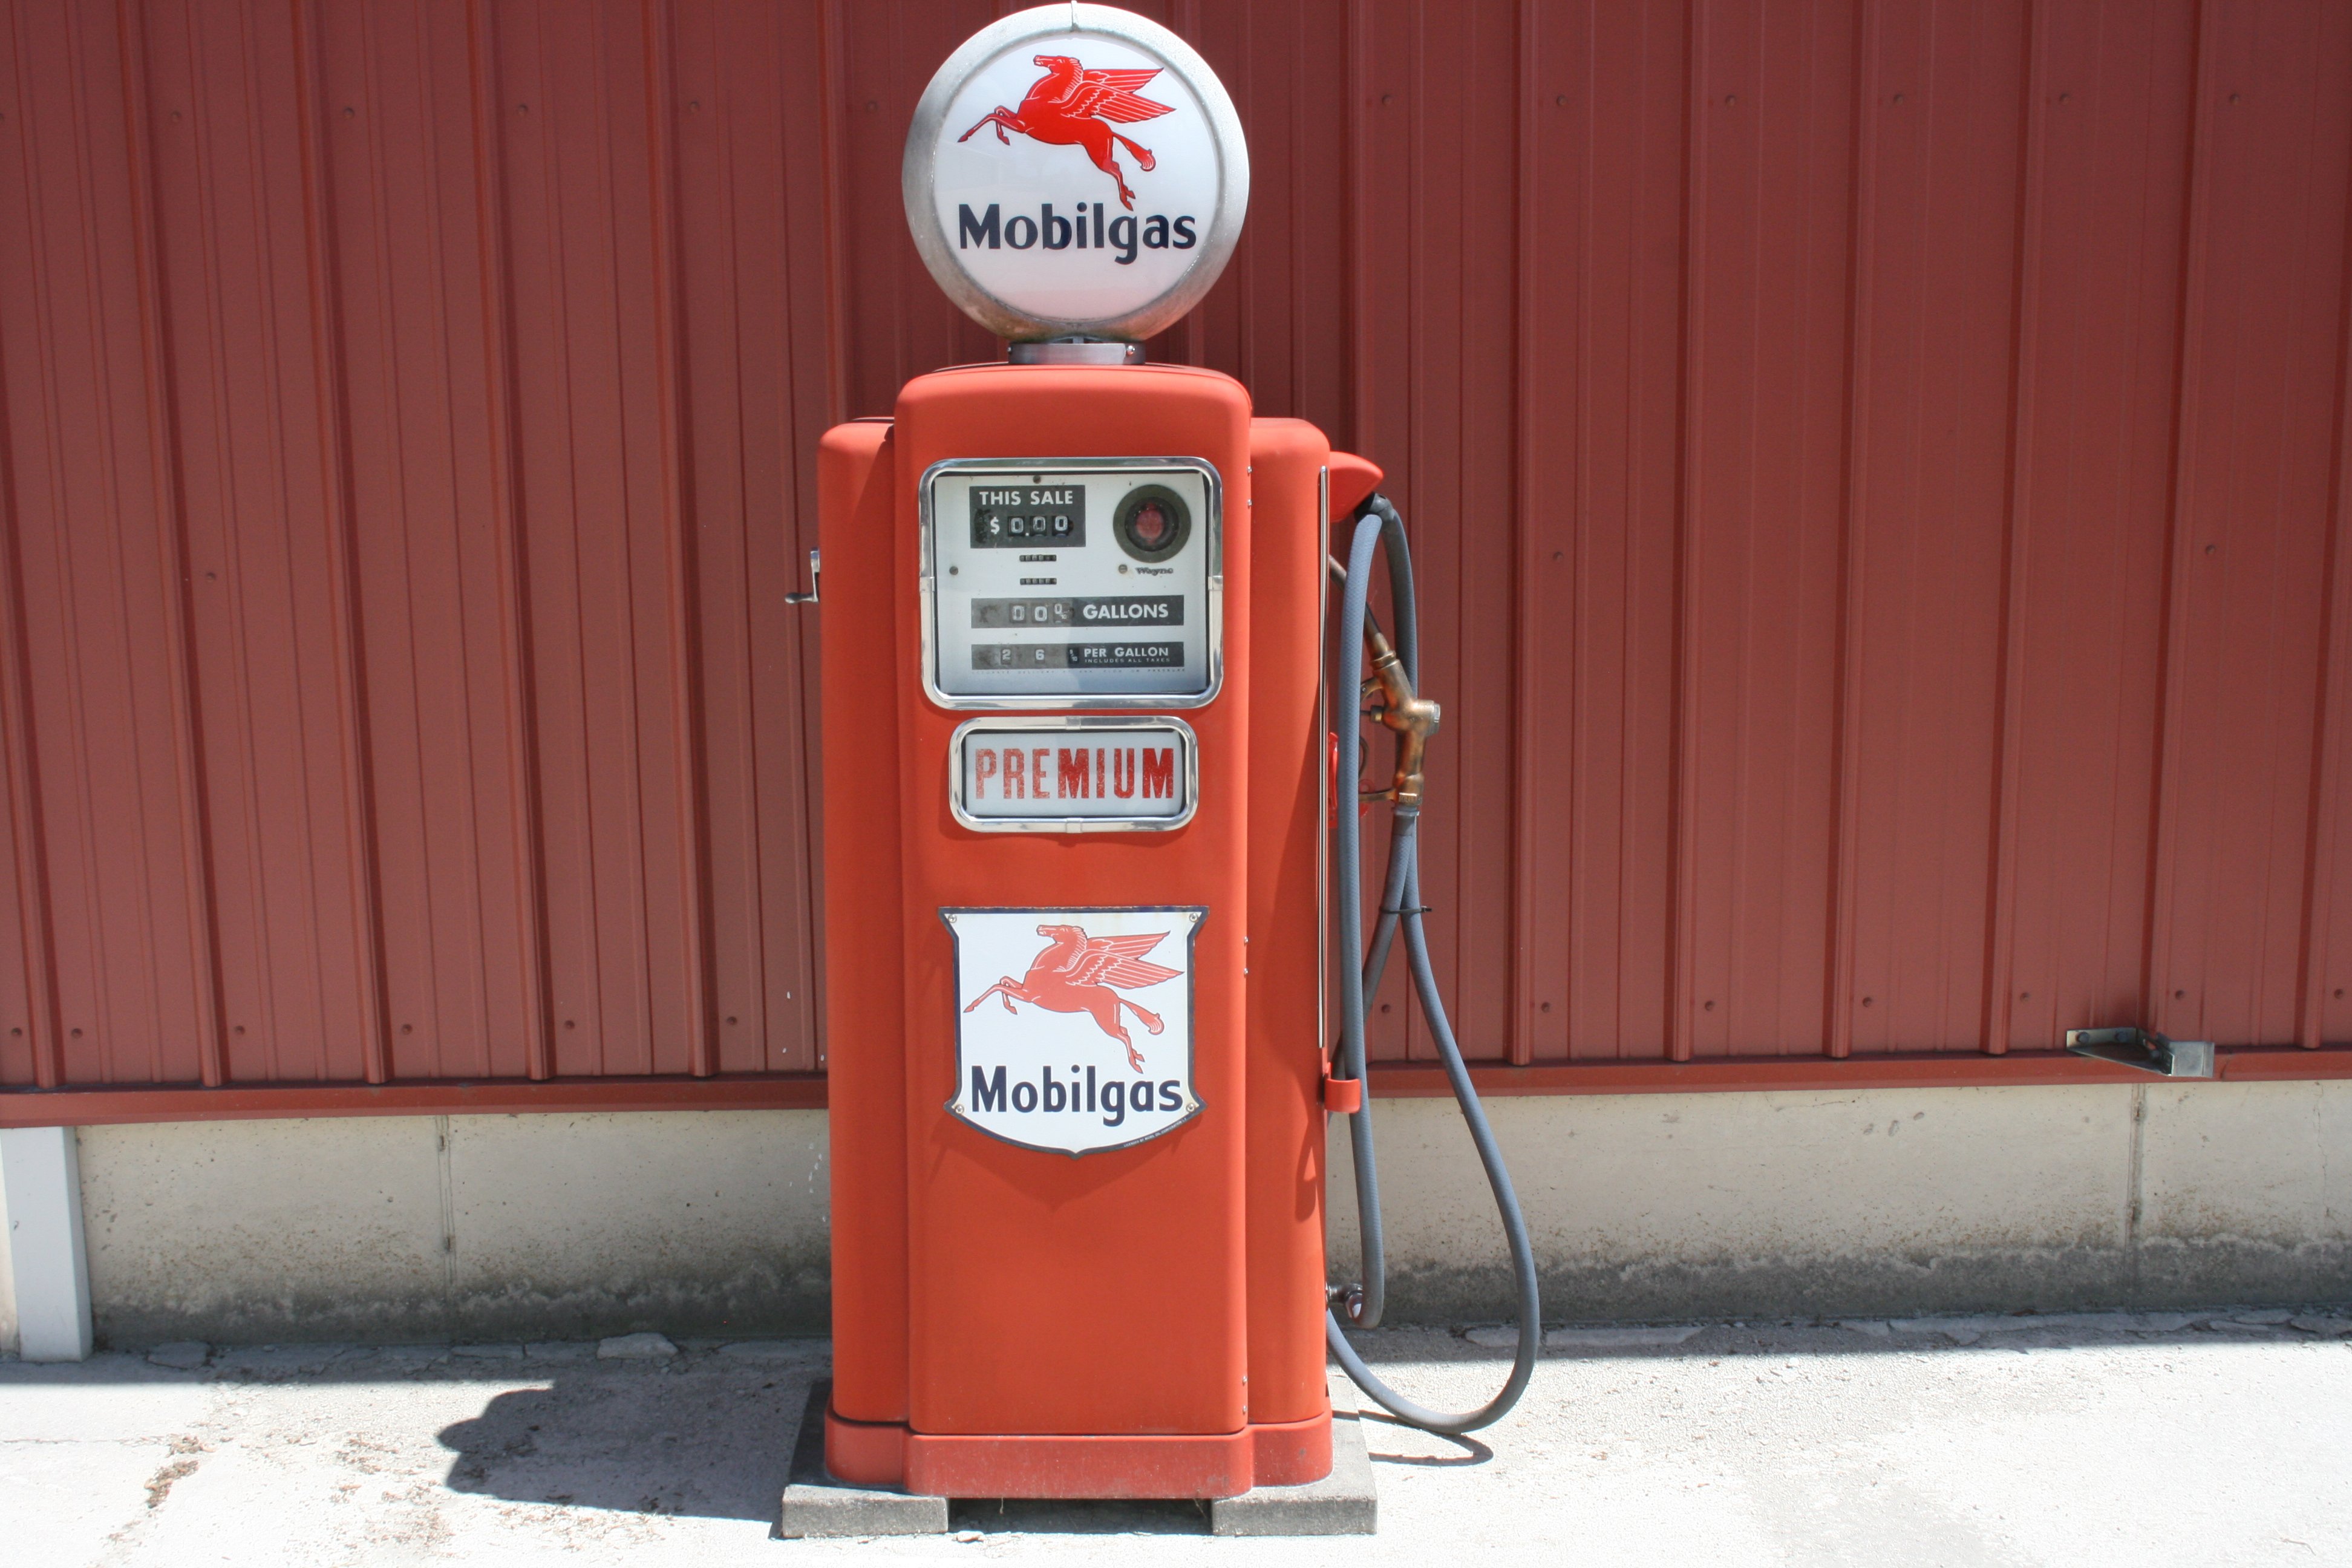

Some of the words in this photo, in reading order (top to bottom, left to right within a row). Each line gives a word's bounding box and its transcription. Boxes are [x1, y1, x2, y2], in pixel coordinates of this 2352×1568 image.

[958, 201, 1197, 265] Mobilgas
[979, 491, 1021, 505] THIS
[1030, 491, 1073, 505] SALE
[1082, 603, 1169, 619] GALLONS
[1084, 648, 1107, 658] PER
[1114, 646, 1169, 657] GALLON
[975, 748, 1174, 799] PREMIUM
[971, 1064, 1183, 1126] Mobilgas
